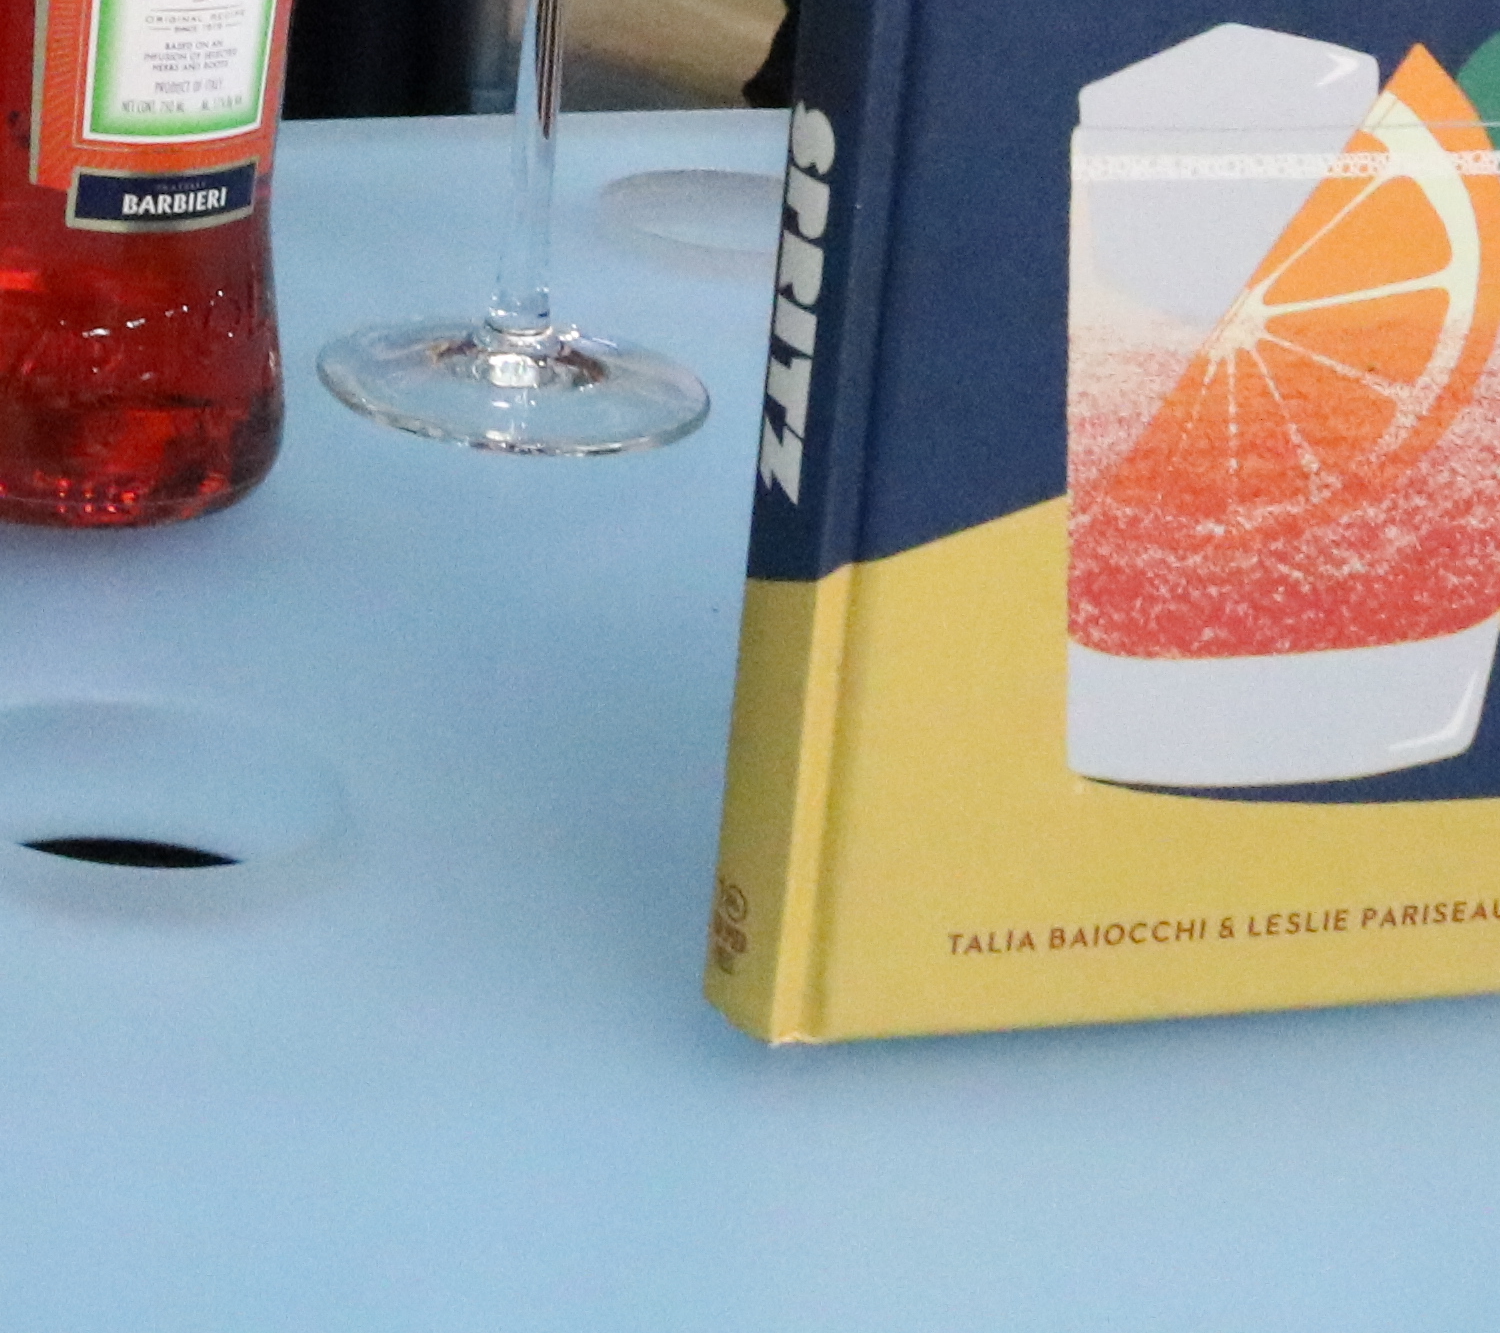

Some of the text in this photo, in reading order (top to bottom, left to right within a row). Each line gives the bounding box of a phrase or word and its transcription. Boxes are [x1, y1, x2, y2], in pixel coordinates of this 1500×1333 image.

[121, 186, 228, 216] BARBIERI
[758, 99, 836, 506] SPRITZ
[946, 929, 1037, 956] TALIA
[1047, 917, 1208, 951] BAIOCCHI
[1247, 907, 1350, 938] LESLIE
